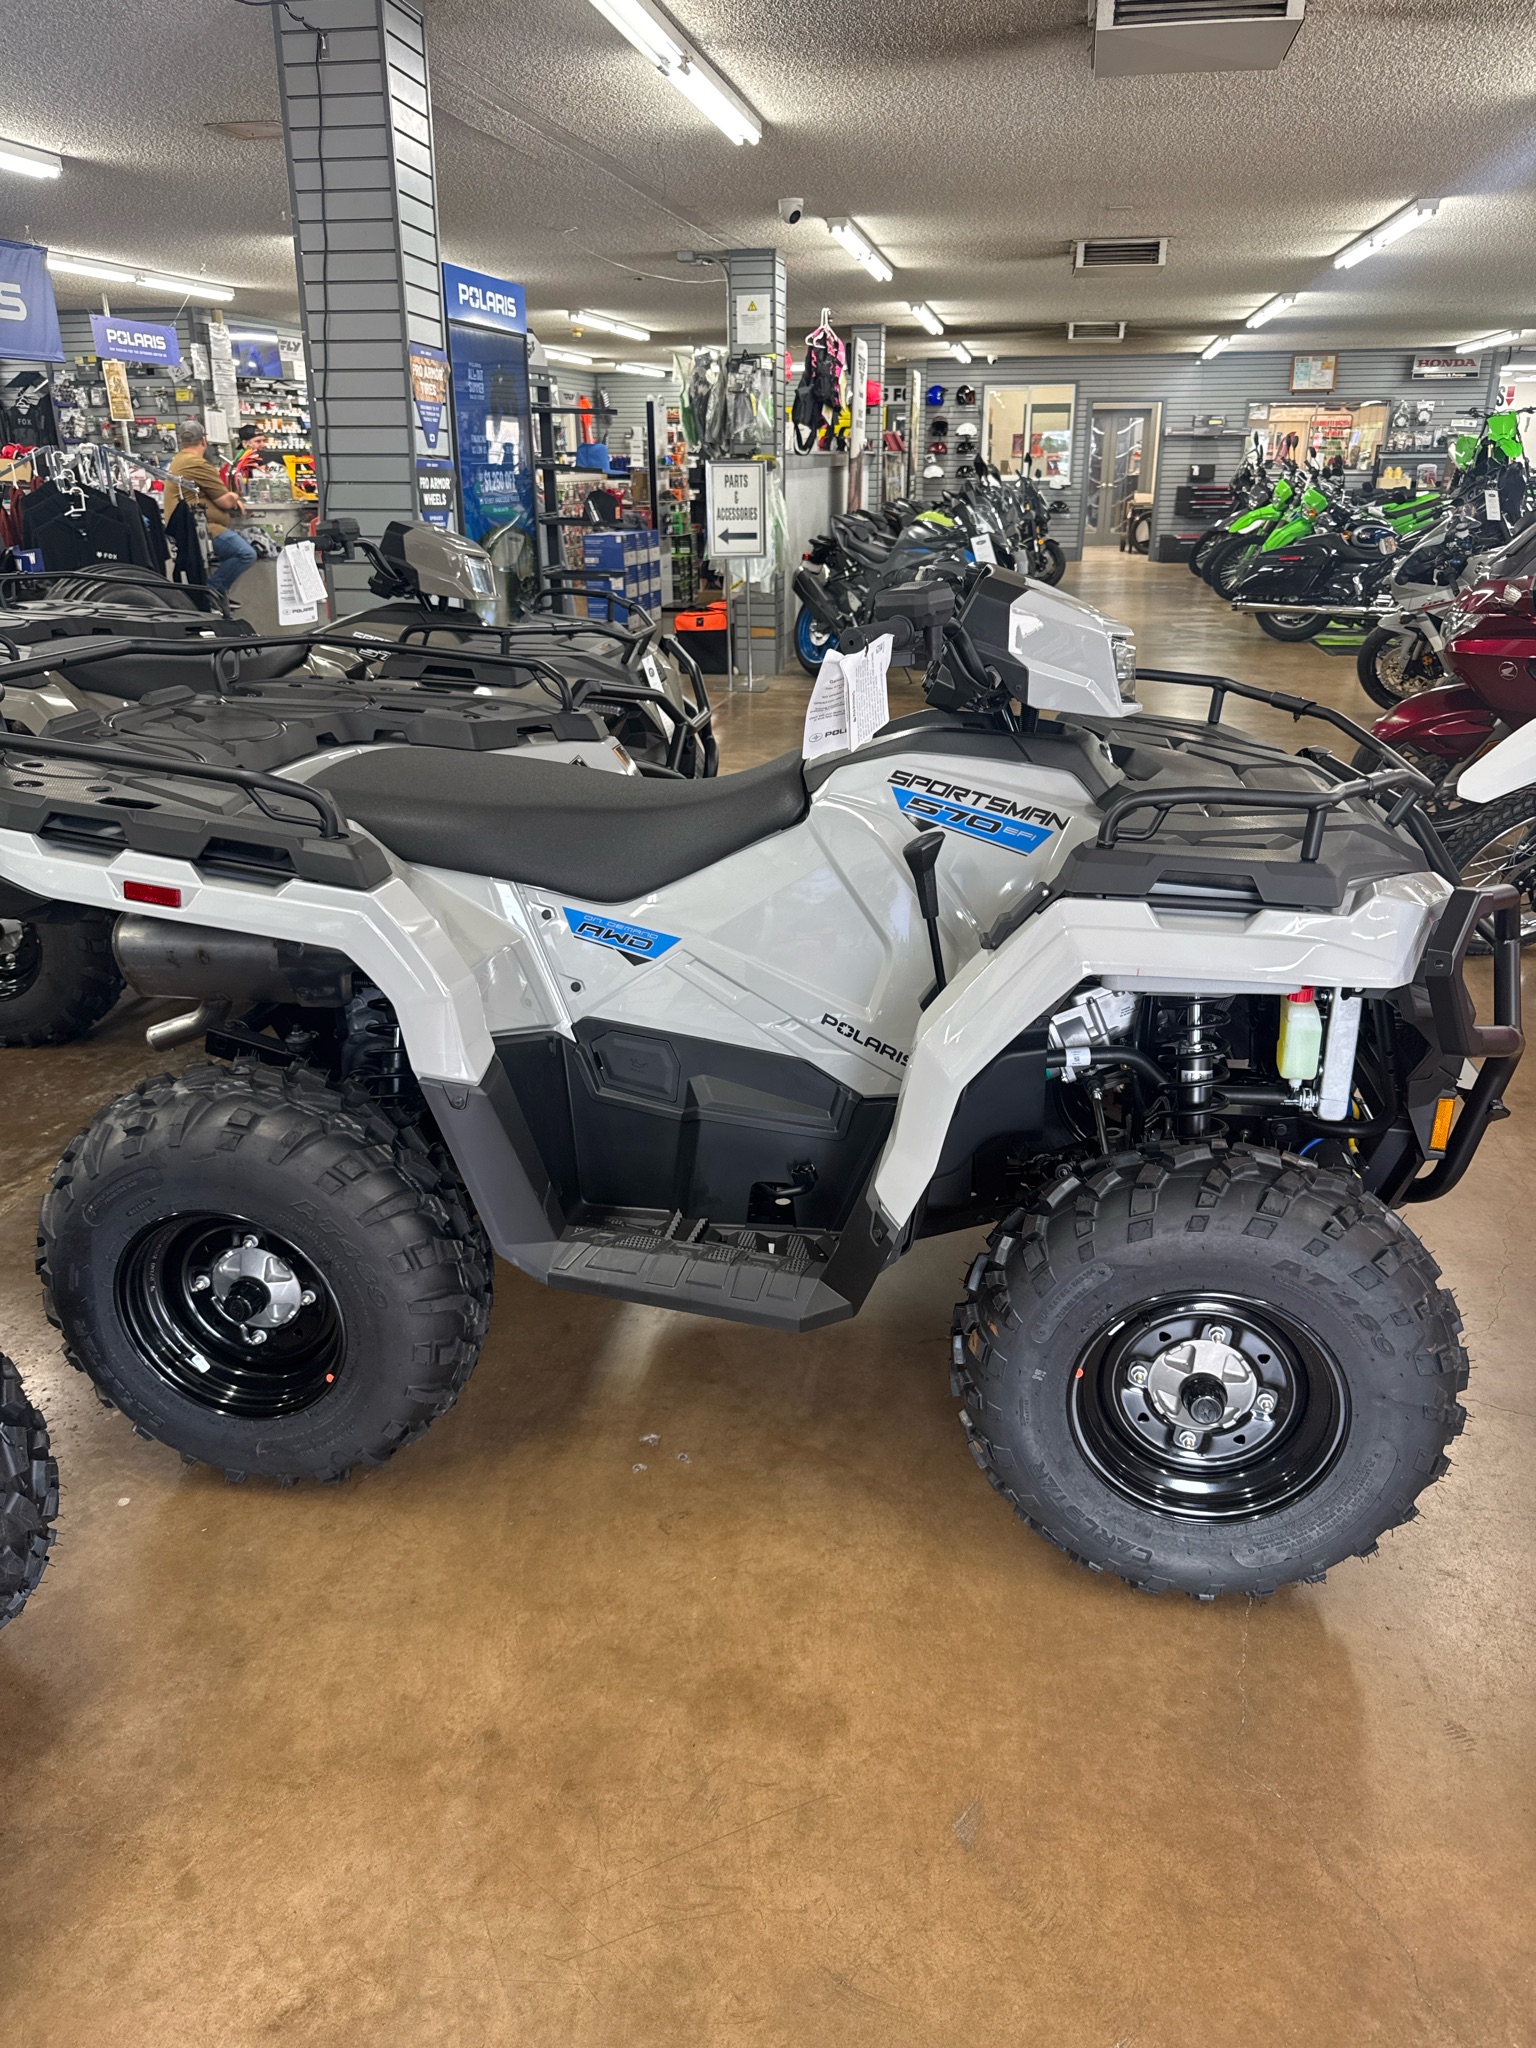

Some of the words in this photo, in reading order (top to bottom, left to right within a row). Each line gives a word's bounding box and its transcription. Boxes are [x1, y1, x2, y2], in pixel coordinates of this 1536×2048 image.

[458, 283, 517, 318] POLARIS
[106, 329, 167, 350] POLARIS
[1416, 358, 1477, 368] HONDA
[412, 364, 424, 377] PRO
[424, 366, 444, 381] ARMOR
[419, 381, 437, 396] TIRES
[17, 418, 32, 426] FOX
[419, 476, 430, 490] PRO
[430, 477, 451, 490] ARMOR
[724, 474, 749, 488] PARTS
[423, 493, 447, 506] WHEELS
[716, 507, 758, 521] ACCESSORIES
[887, 770, 1071, 830] SPORTSMAN
[904, 796, 1002, 834] 570
[1003, 826, 1036, 841] EFI
[576, 921, 654, 951] AWD
[1028, 1460, 1153, 1564] CARLSTAR
